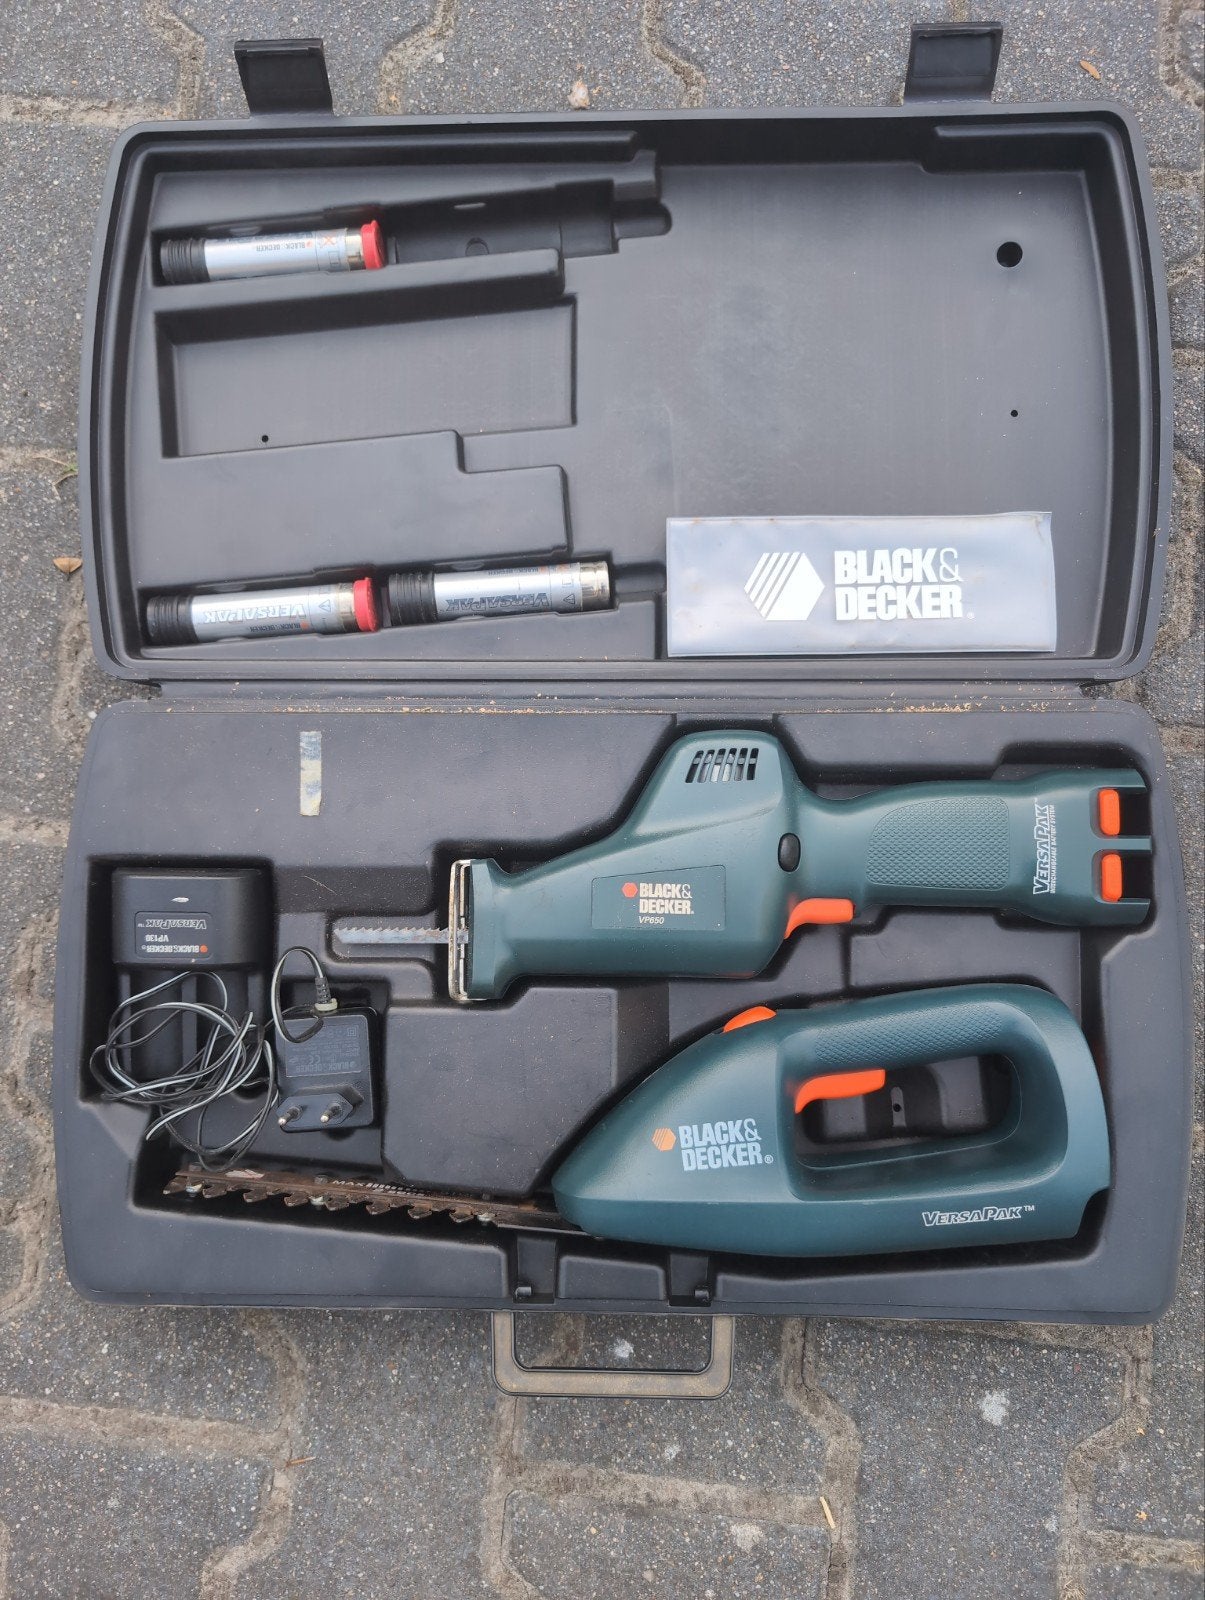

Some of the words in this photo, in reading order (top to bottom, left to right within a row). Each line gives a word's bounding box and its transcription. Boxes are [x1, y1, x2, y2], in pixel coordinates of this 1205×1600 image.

[834, 547, 964, 584] BLACK&
[205, 603, 306, 624] VERSAPAK
[640, 882, 692, 899] BLACK&
[638, 916, 665, 925] VP650
[678, 1118, 762, 1149] BLACK&
